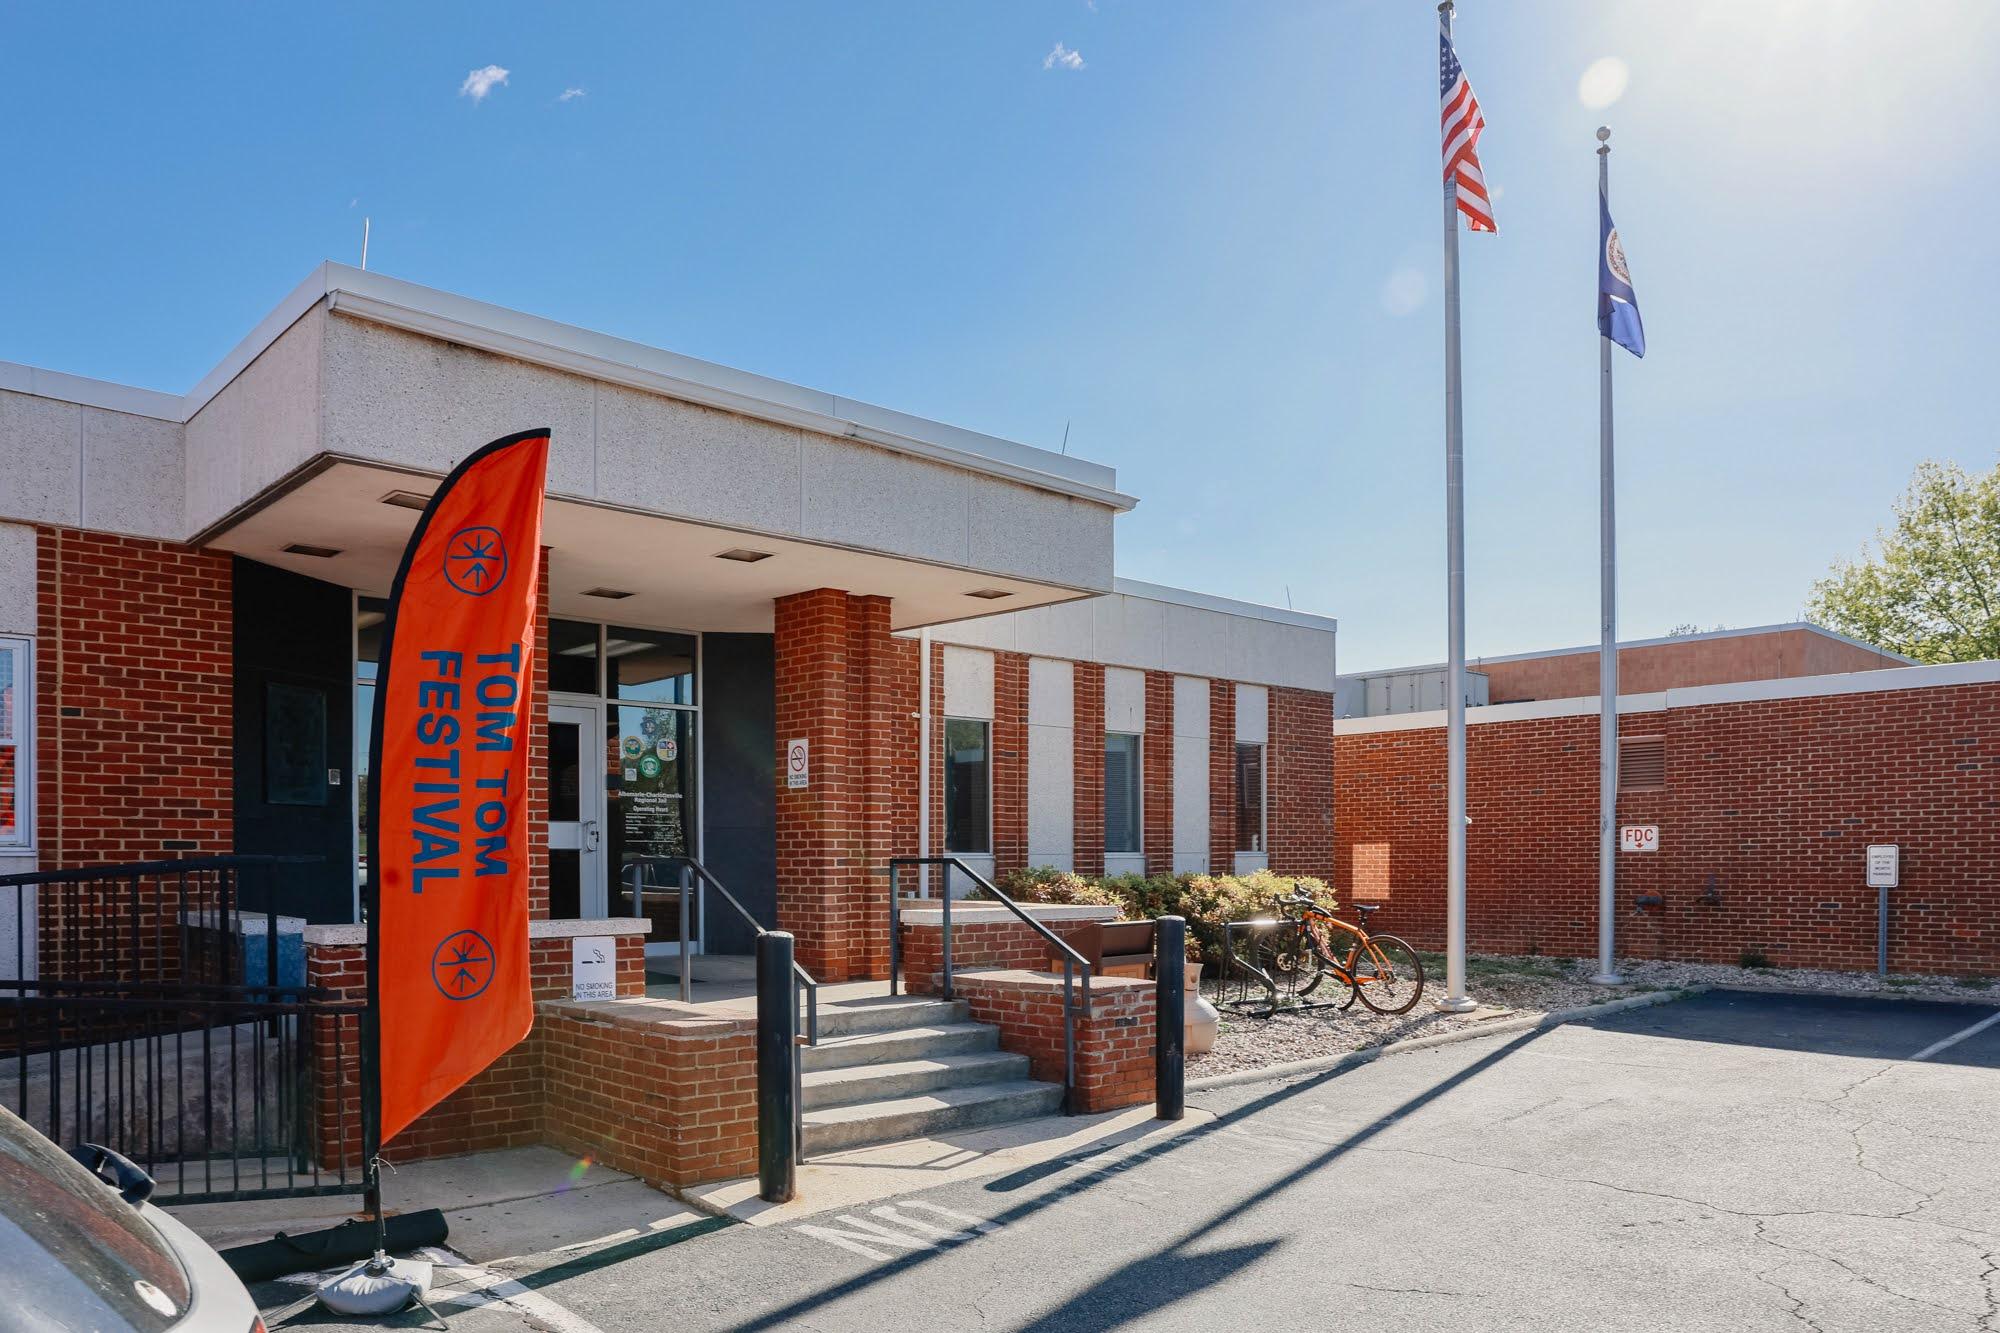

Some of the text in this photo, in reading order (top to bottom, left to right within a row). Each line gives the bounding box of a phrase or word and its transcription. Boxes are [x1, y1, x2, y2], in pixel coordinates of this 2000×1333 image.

[474, 643, 521, 878] TOM TOM
[411, 650, 464, 895] FESTIVAL
[633, 805, 655, 813] Operating
[1625, 828, 1654, 842] FDC
[575, 982, 613, 991] NO SMOKING
[575, 990, 614, 999] IN THIS AREA
